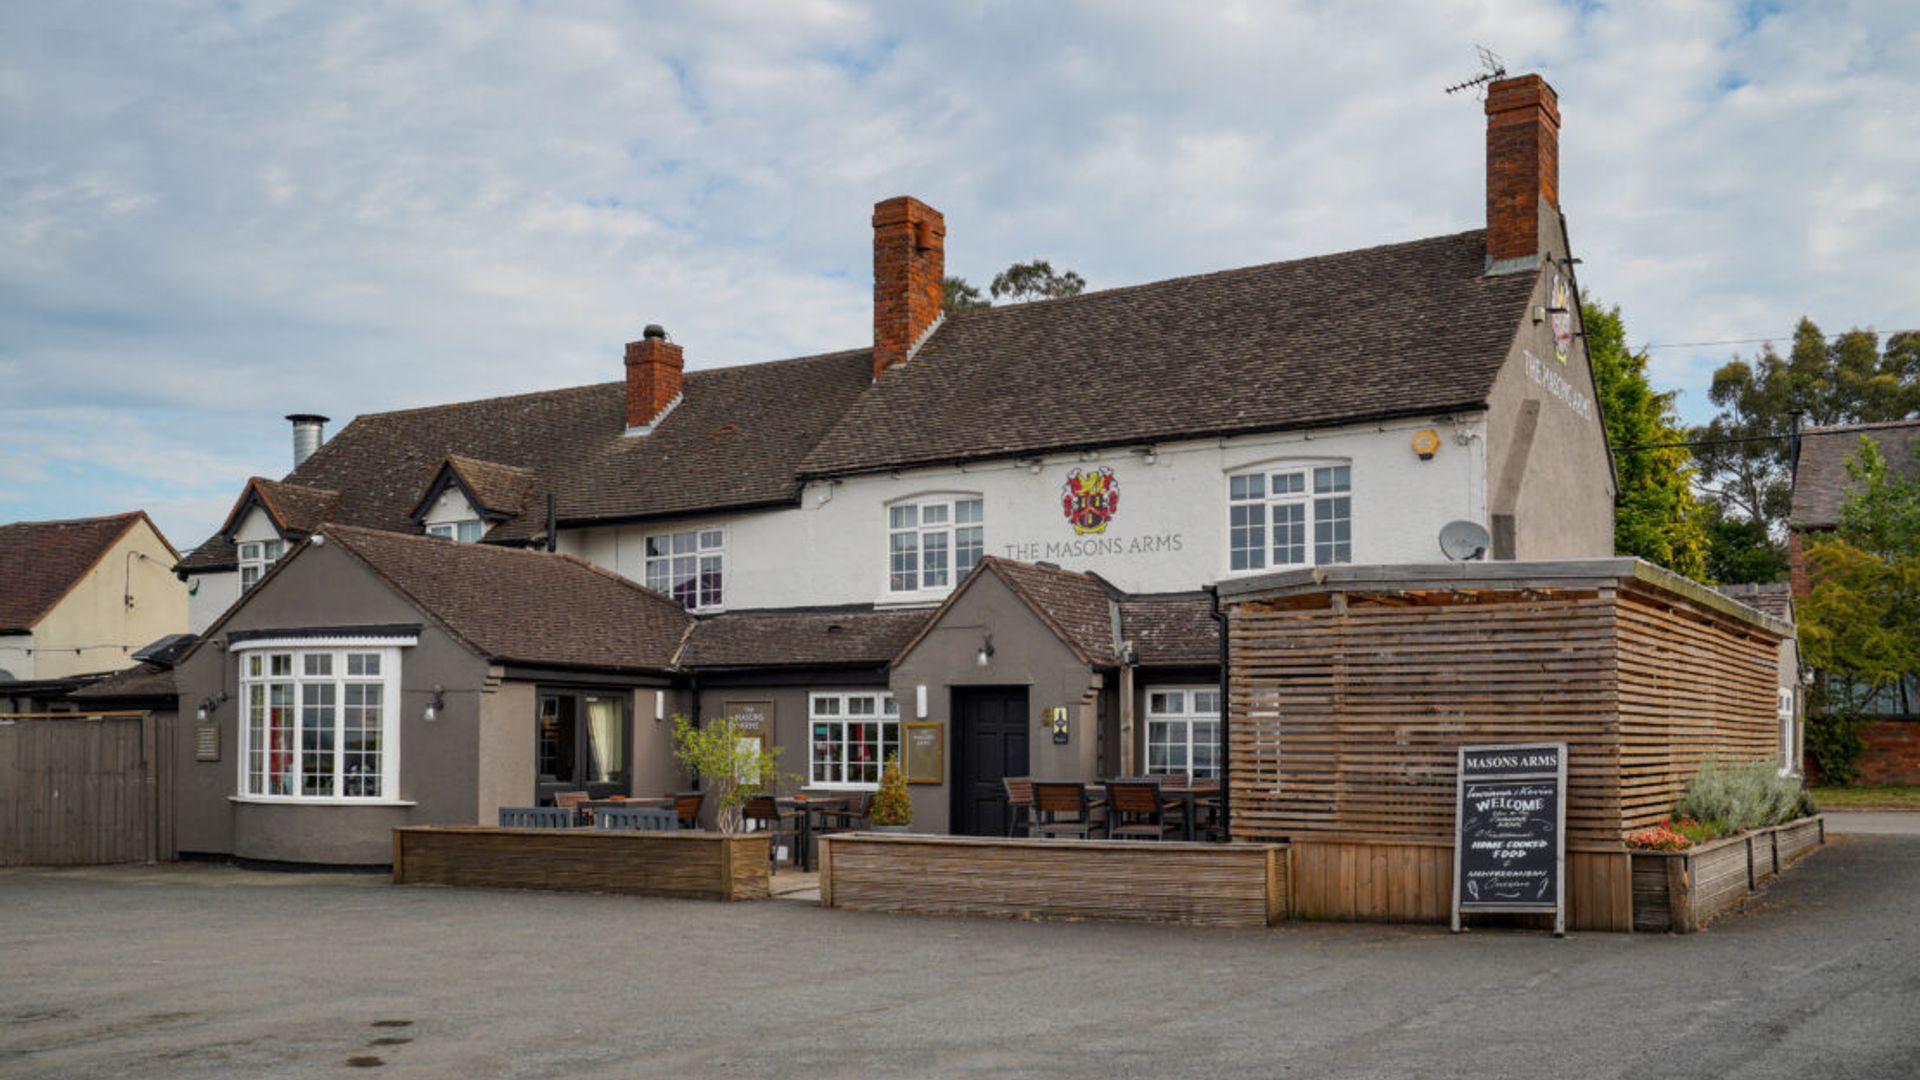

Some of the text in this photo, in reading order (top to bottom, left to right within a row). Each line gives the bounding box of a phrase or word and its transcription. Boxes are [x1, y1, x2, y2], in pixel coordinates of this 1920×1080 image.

[1005, 533, 1184, 560] THE MASONS ARMS
[1466, 754, 1558, 770] MASONS ARMS
[1476, 797, 1544, 812] WELCOME
[1492, 849, 1527, 859] FOOD
